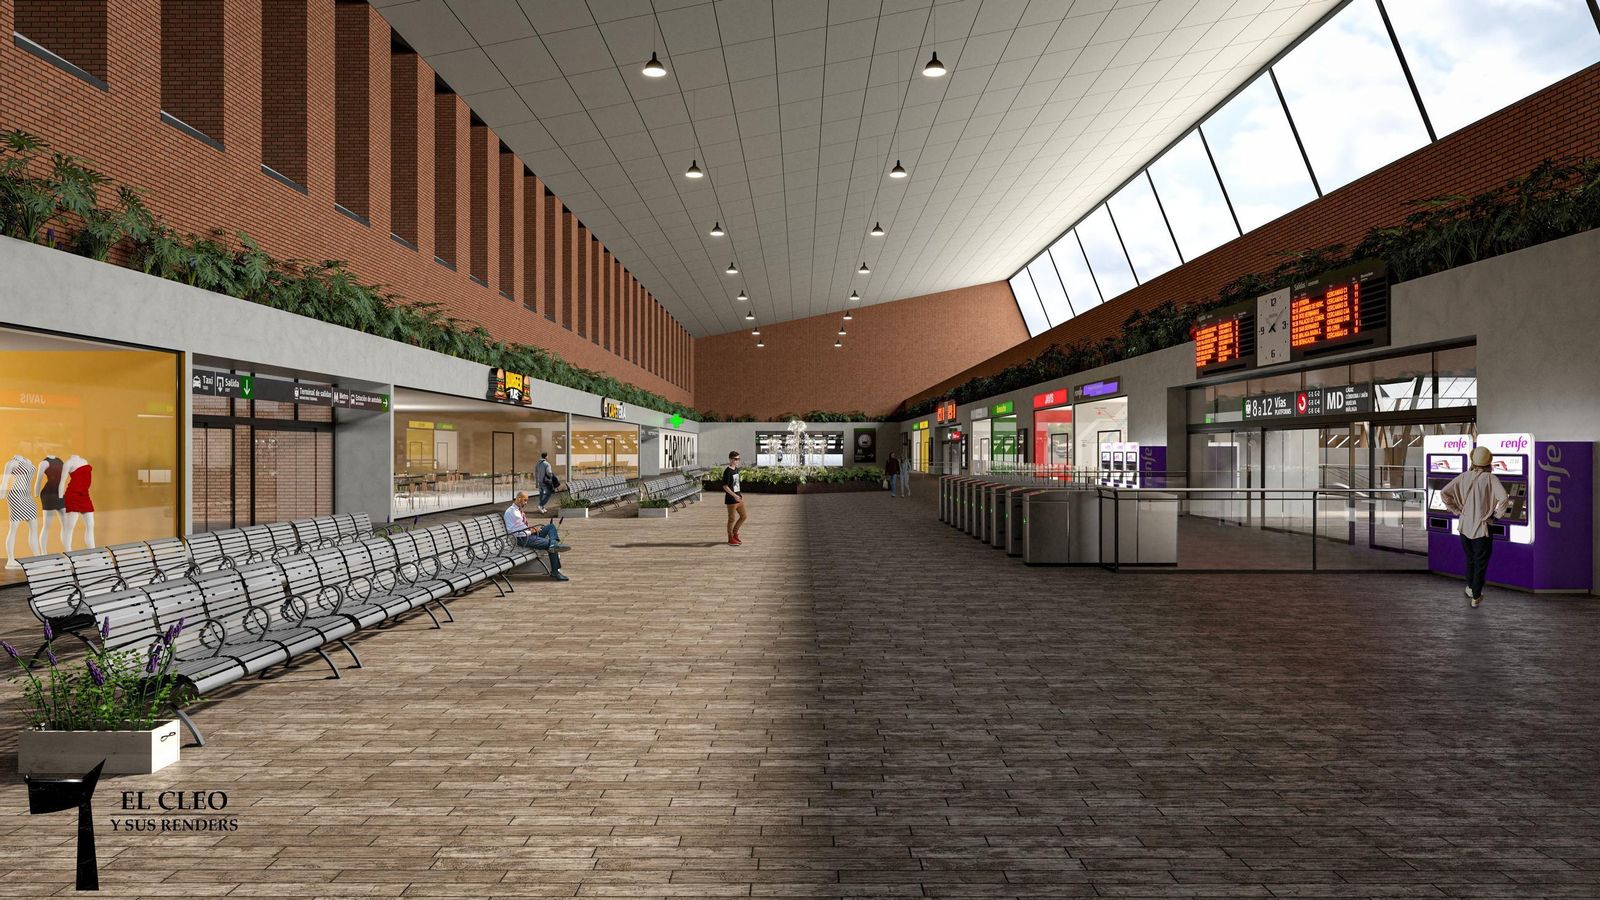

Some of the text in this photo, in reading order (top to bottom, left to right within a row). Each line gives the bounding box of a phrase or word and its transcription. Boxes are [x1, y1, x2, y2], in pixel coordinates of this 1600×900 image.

[1271, 298, 1276, 306] 12
[1282, 321, 1286, 329] 3
[1261, 327, 1264, 335] 9
[1271, 349, 1275, 358] 6
[203, 376, 214, 385] Taxi
[225, 378, 240, 388] Salida
[1274, 396, 1286, 408] Vías
[1327, 392, 1344, 410] MD
[1443, 437, 1466, 452] renfe
[1501, 435, 1528, 452] renfe
[1538, 444, 1570, 528] renfe
